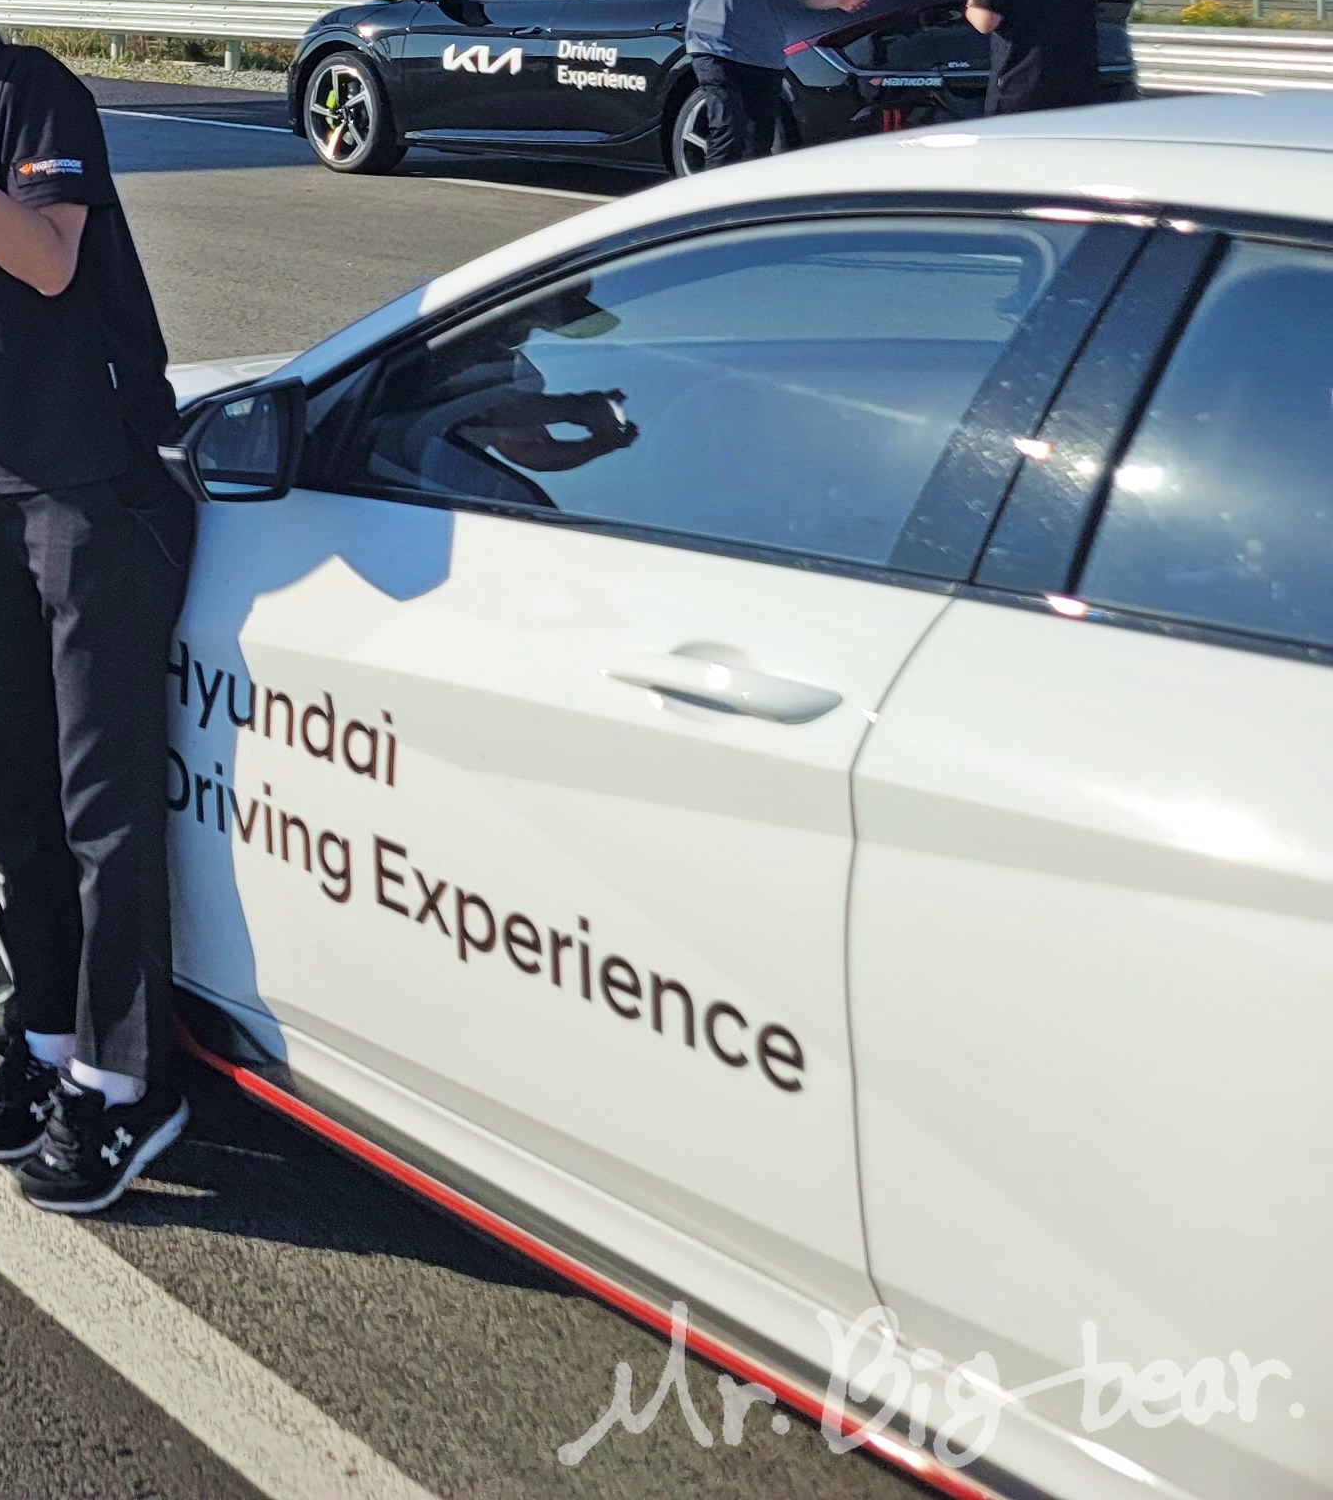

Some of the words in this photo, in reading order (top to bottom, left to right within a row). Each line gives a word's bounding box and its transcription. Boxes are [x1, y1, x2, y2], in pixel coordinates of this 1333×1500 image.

[557, 40, 618, 67] Driving
[557, 65, 647, 92] Experience
[374, 833, 807, 1094] Experience
